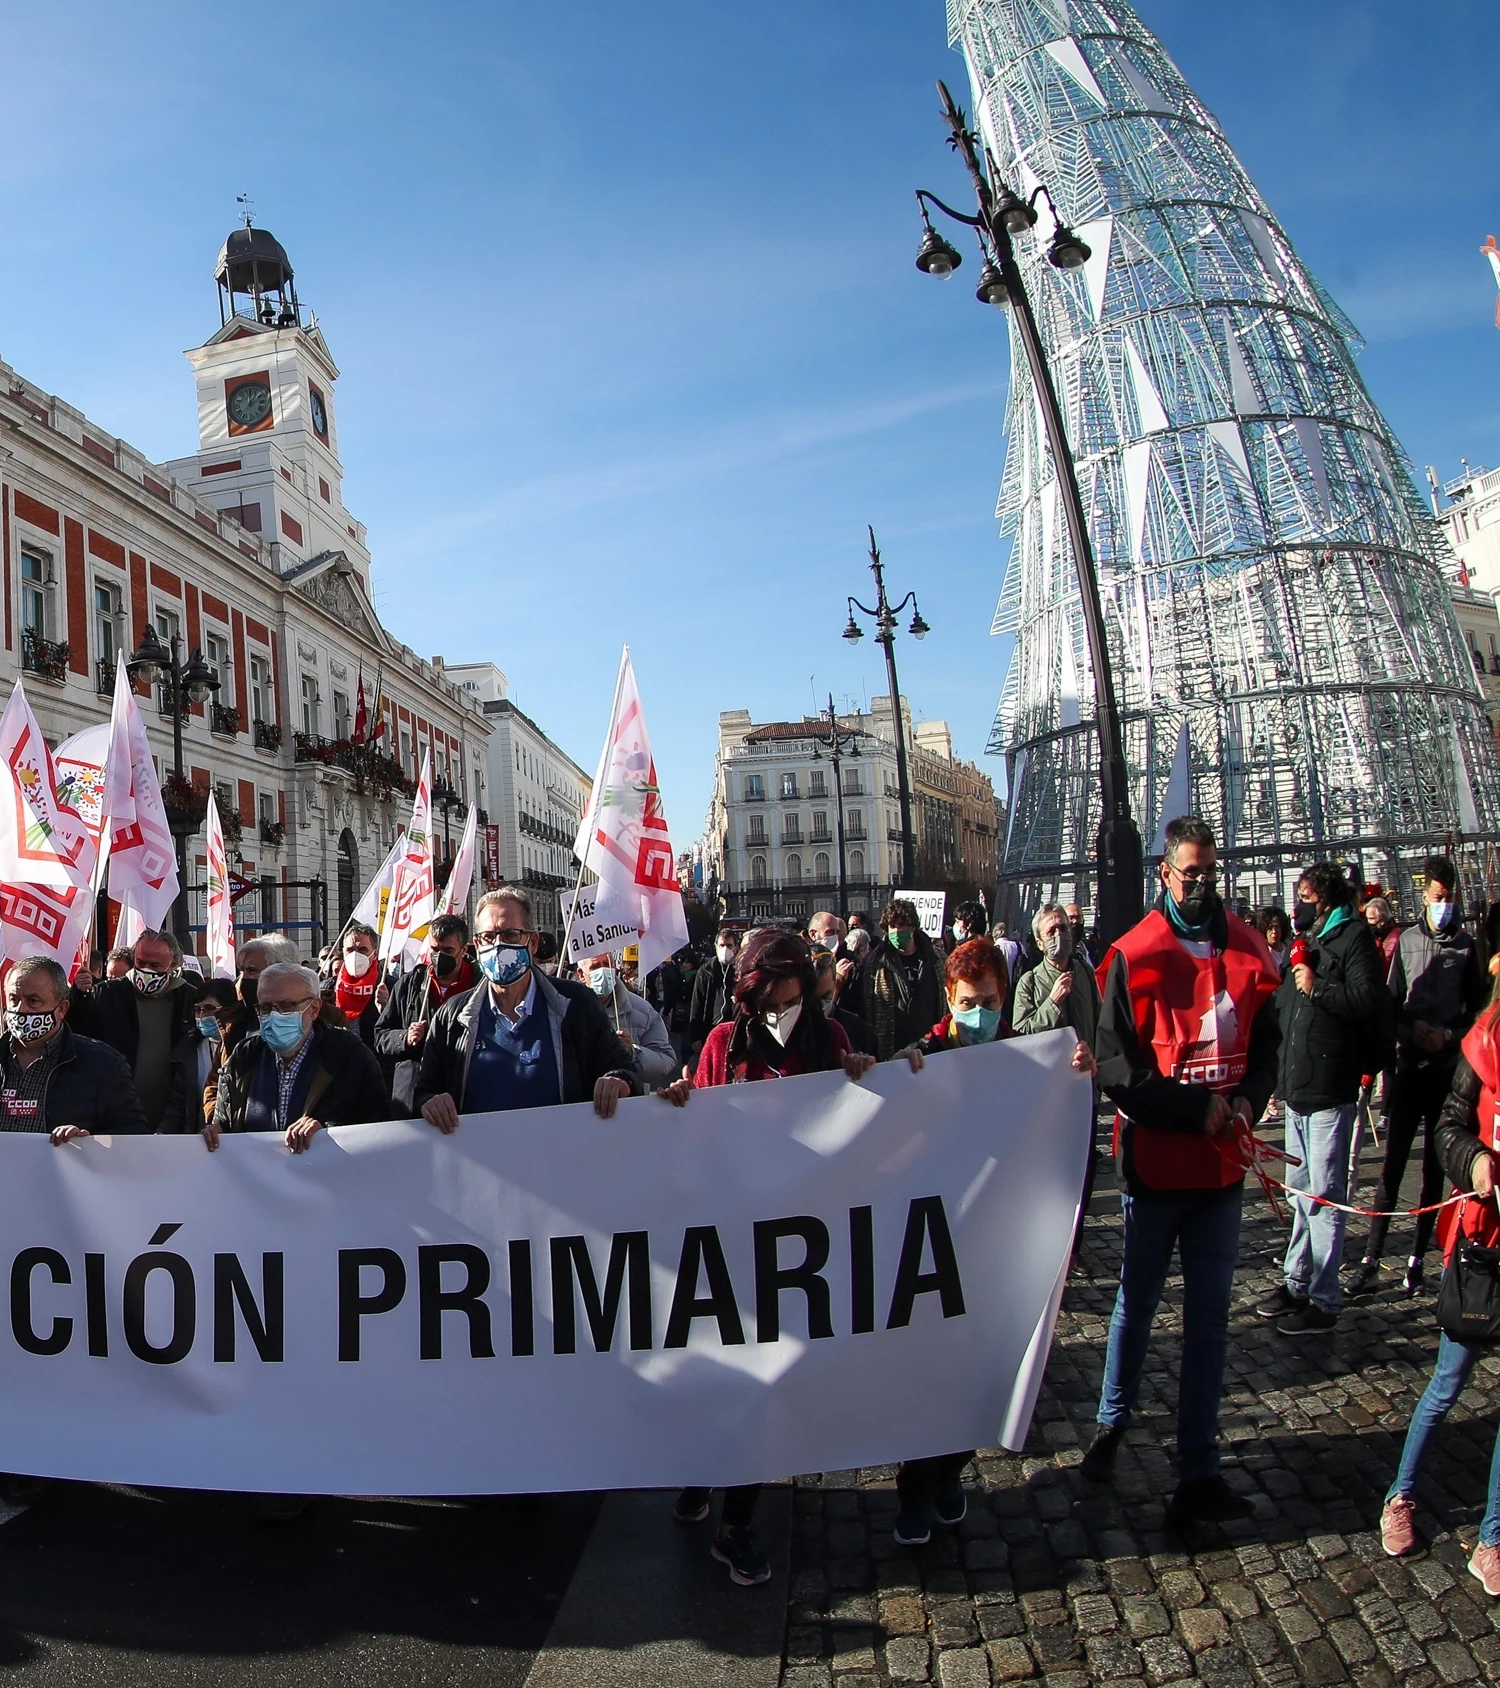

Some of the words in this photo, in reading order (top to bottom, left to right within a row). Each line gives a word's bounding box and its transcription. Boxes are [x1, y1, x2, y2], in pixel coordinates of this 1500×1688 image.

[571, 939, 580, 952] a
[582, 930, 595, 949] la
[8, 1099, 38, 1109] CCOO
[337, 1194, 967, 1363] PRIMARIA
